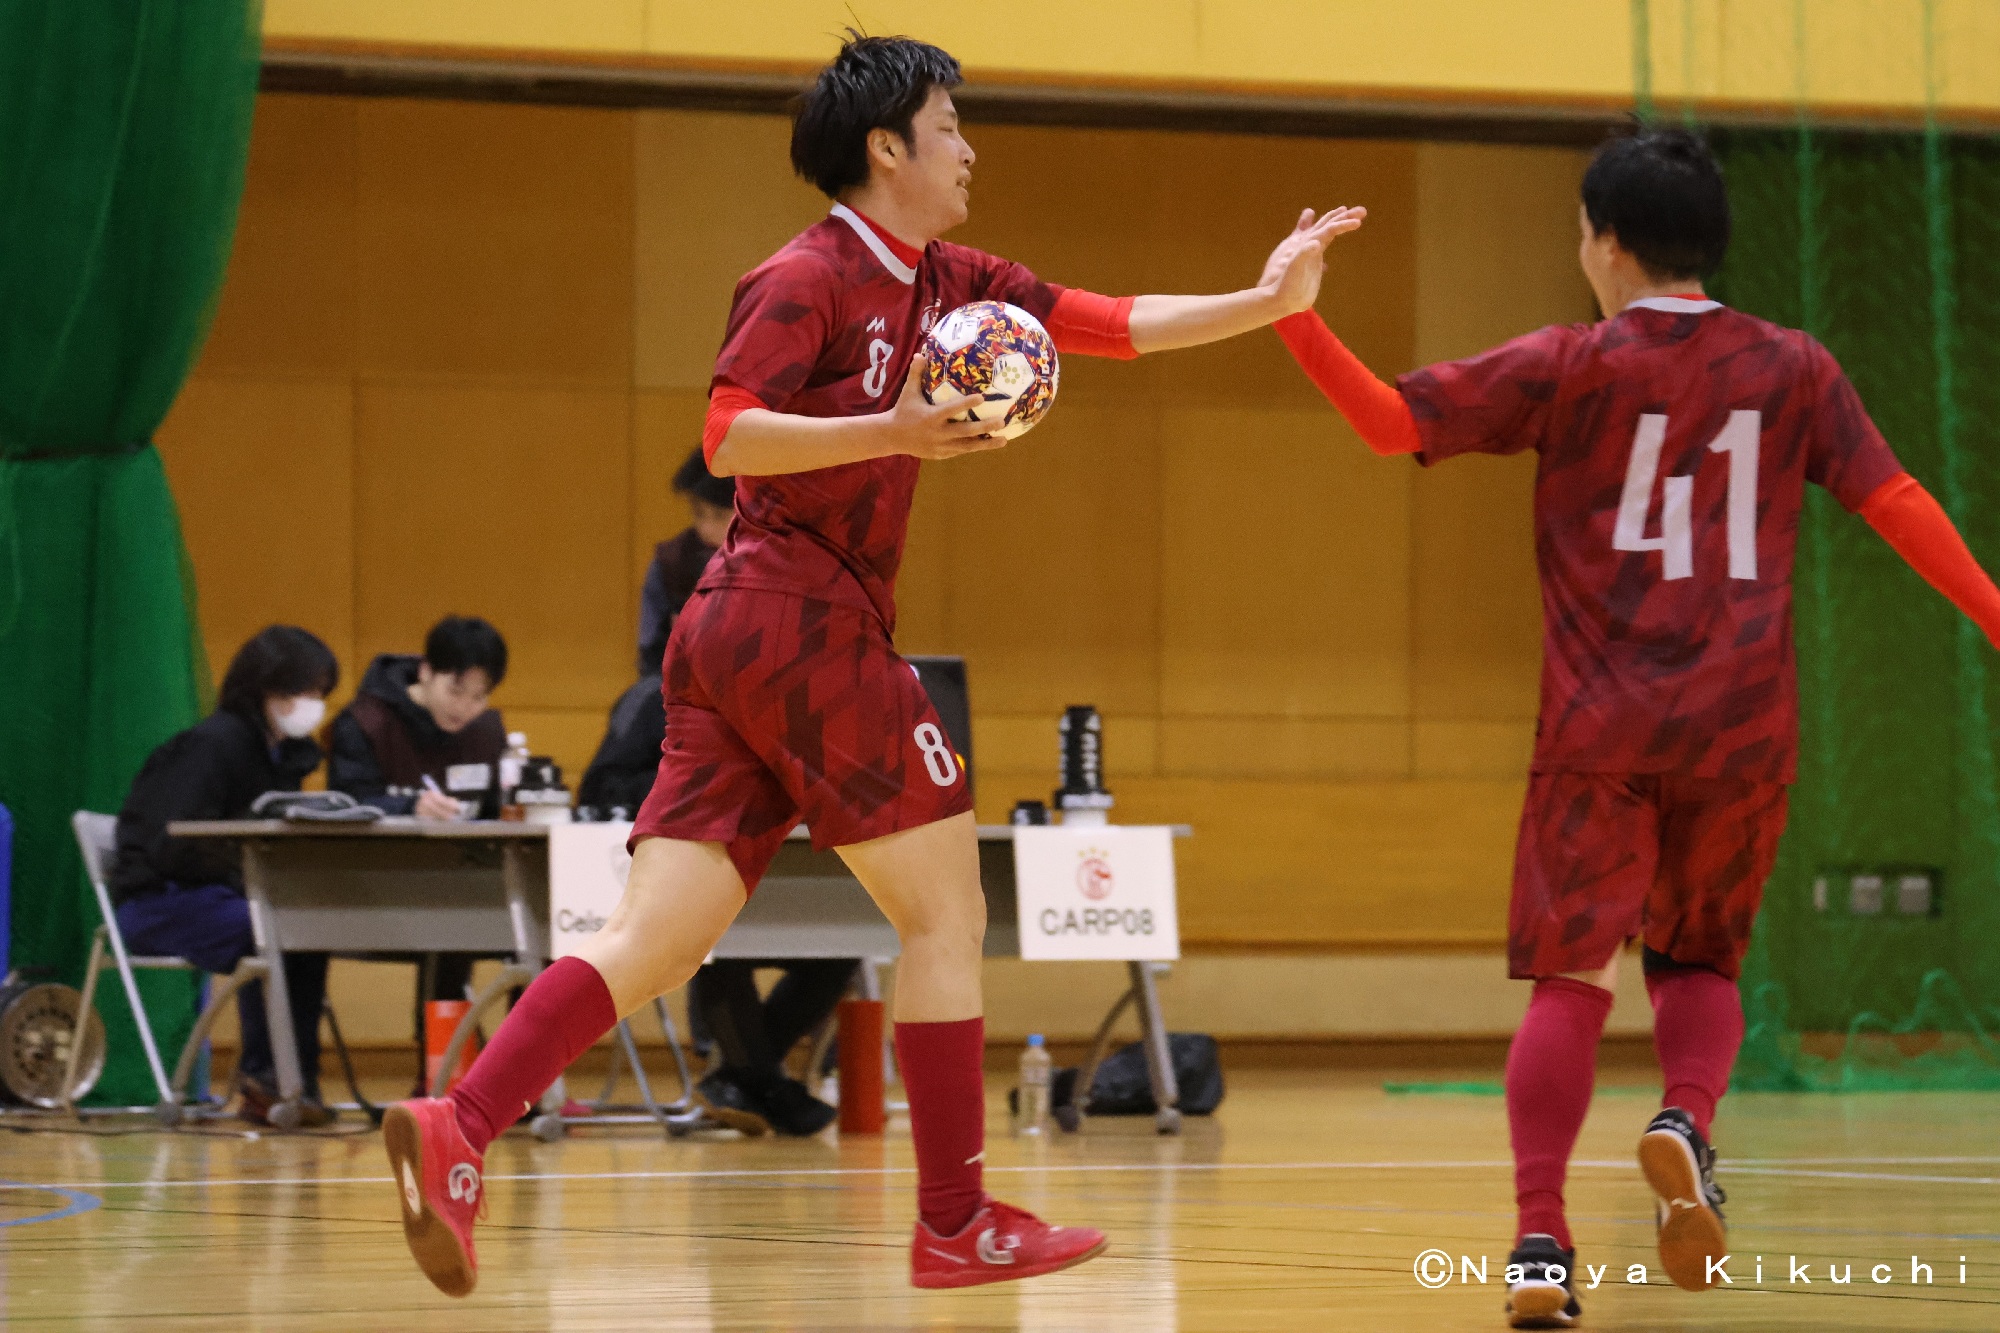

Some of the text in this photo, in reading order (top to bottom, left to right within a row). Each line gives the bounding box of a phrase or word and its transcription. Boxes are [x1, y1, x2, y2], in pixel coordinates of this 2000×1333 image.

[863, 338, 894, 398] 8
[1612, 409, 1761, 581] 41
[913, 722, 958, 787] 8
[1040, 908, 1155, 935] CARP08
